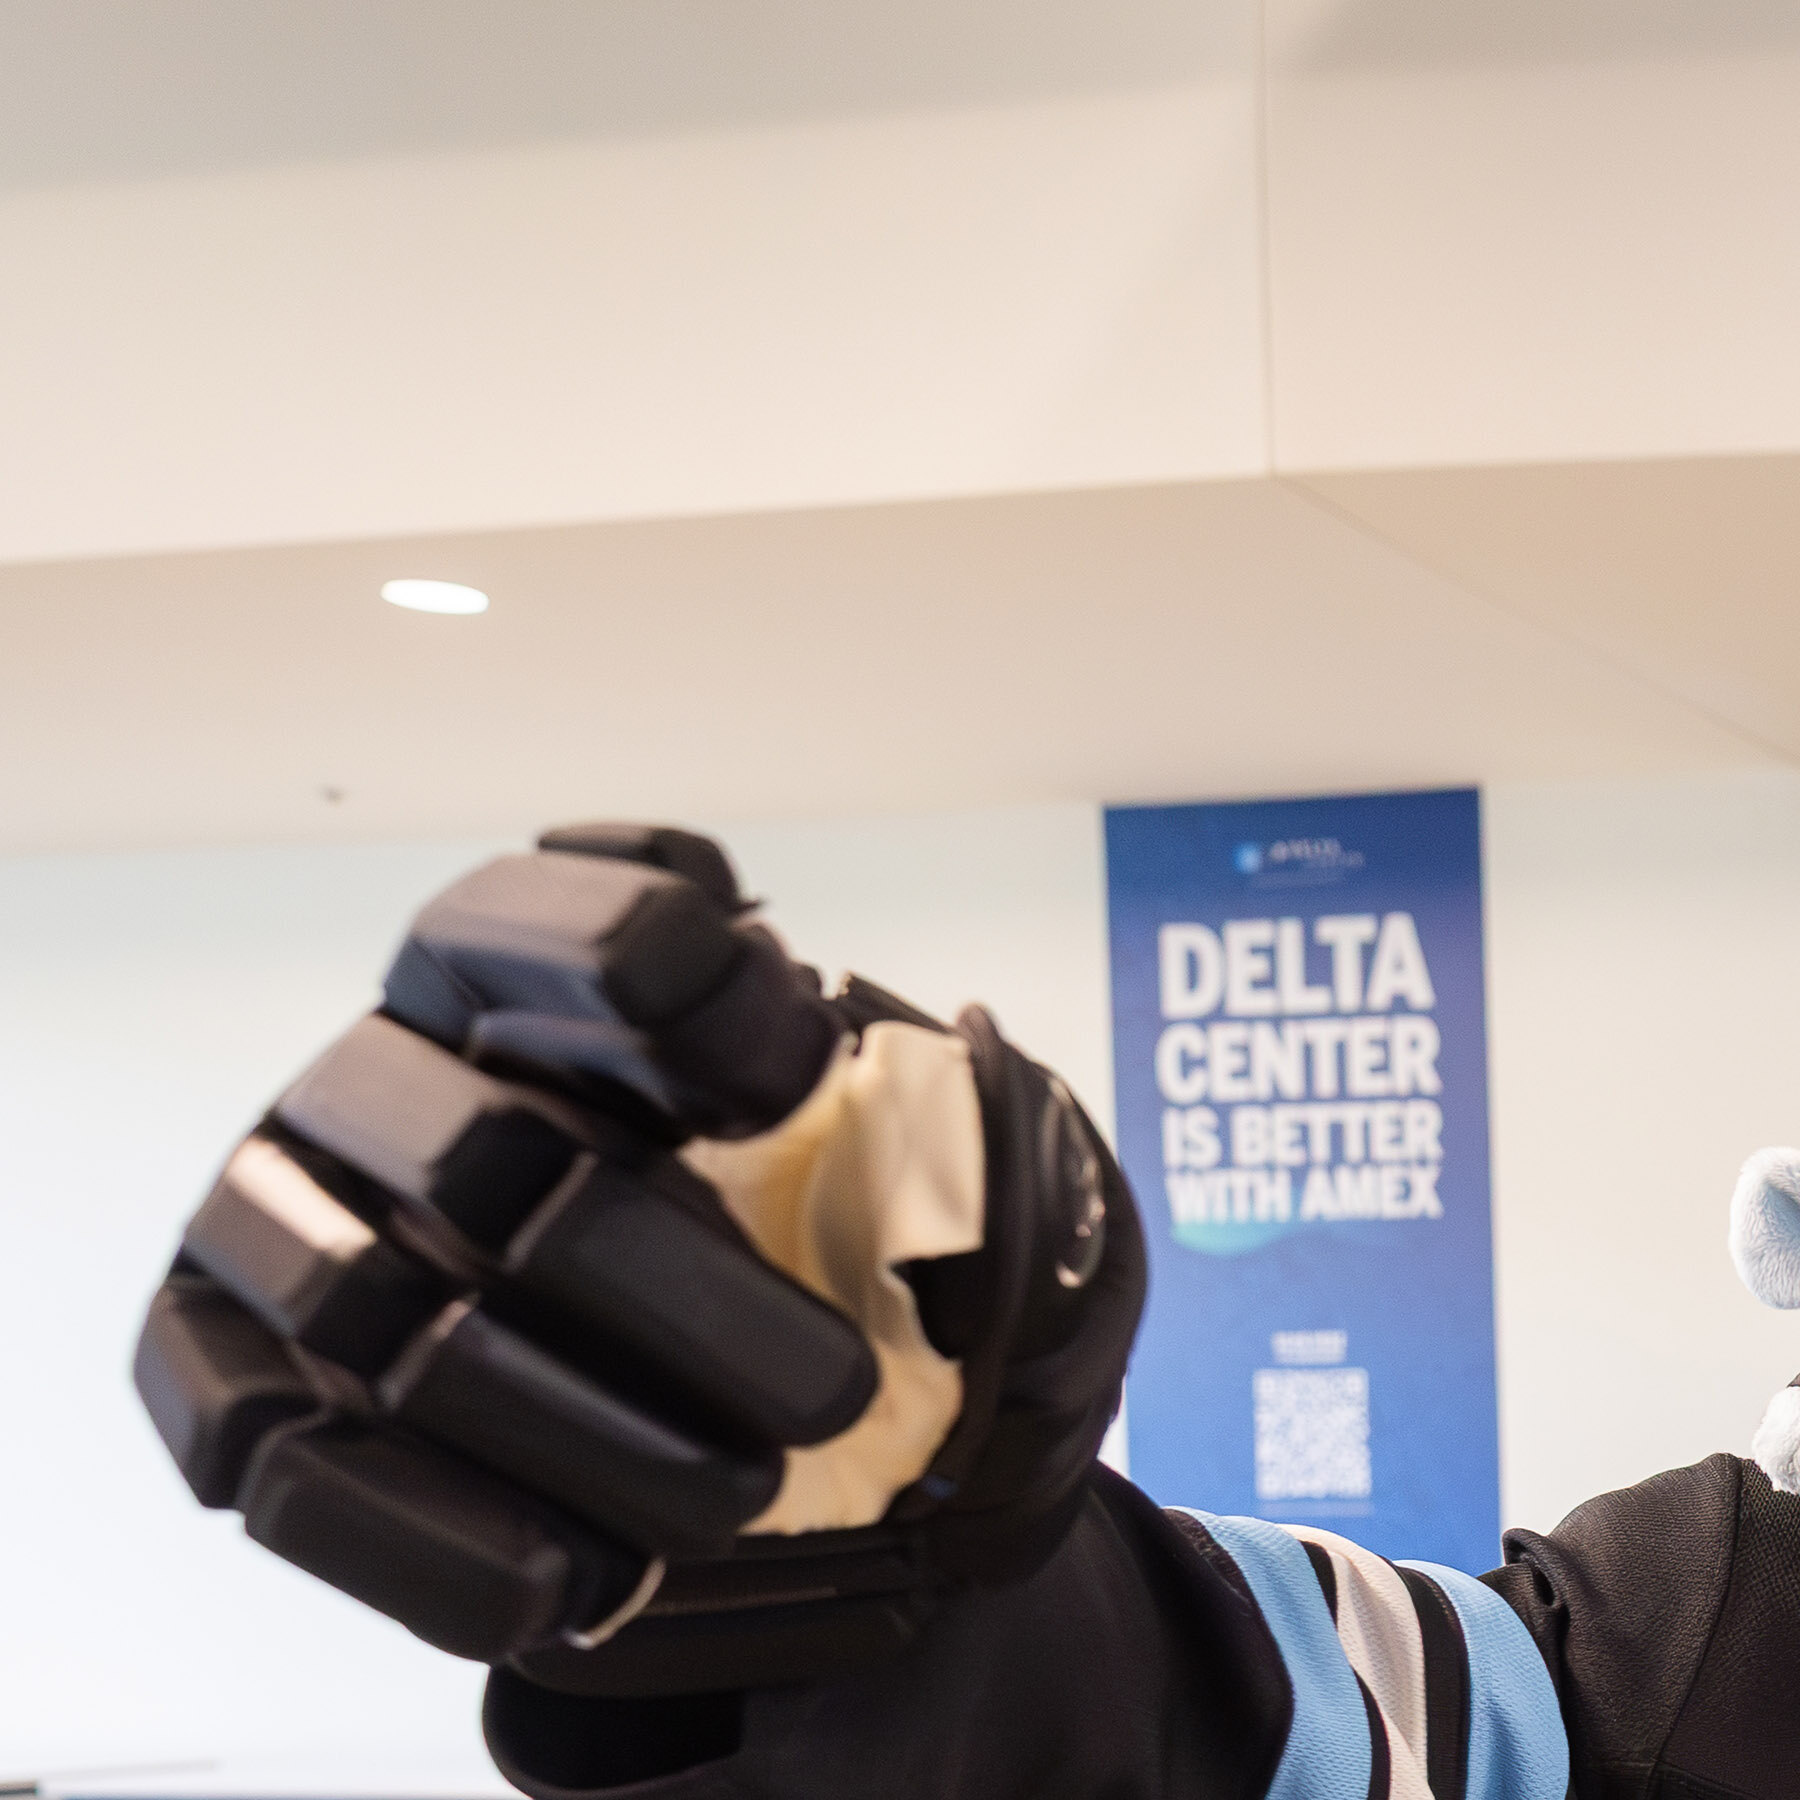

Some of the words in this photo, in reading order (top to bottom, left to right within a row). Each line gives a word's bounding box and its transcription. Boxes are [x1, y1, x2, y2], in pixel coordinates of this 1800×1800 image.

[1158, 911, 1436, 1020] DELTA
[1155, 1012, 1443, 1104] CENTER
[1161, 1103, 1222, 1169] IS
[1230, 1099, 1444, 1167] BETTER
[1165, 1166, 1292, 1224] WITH
[1301, 1163, 1445, 1221] AMEX
